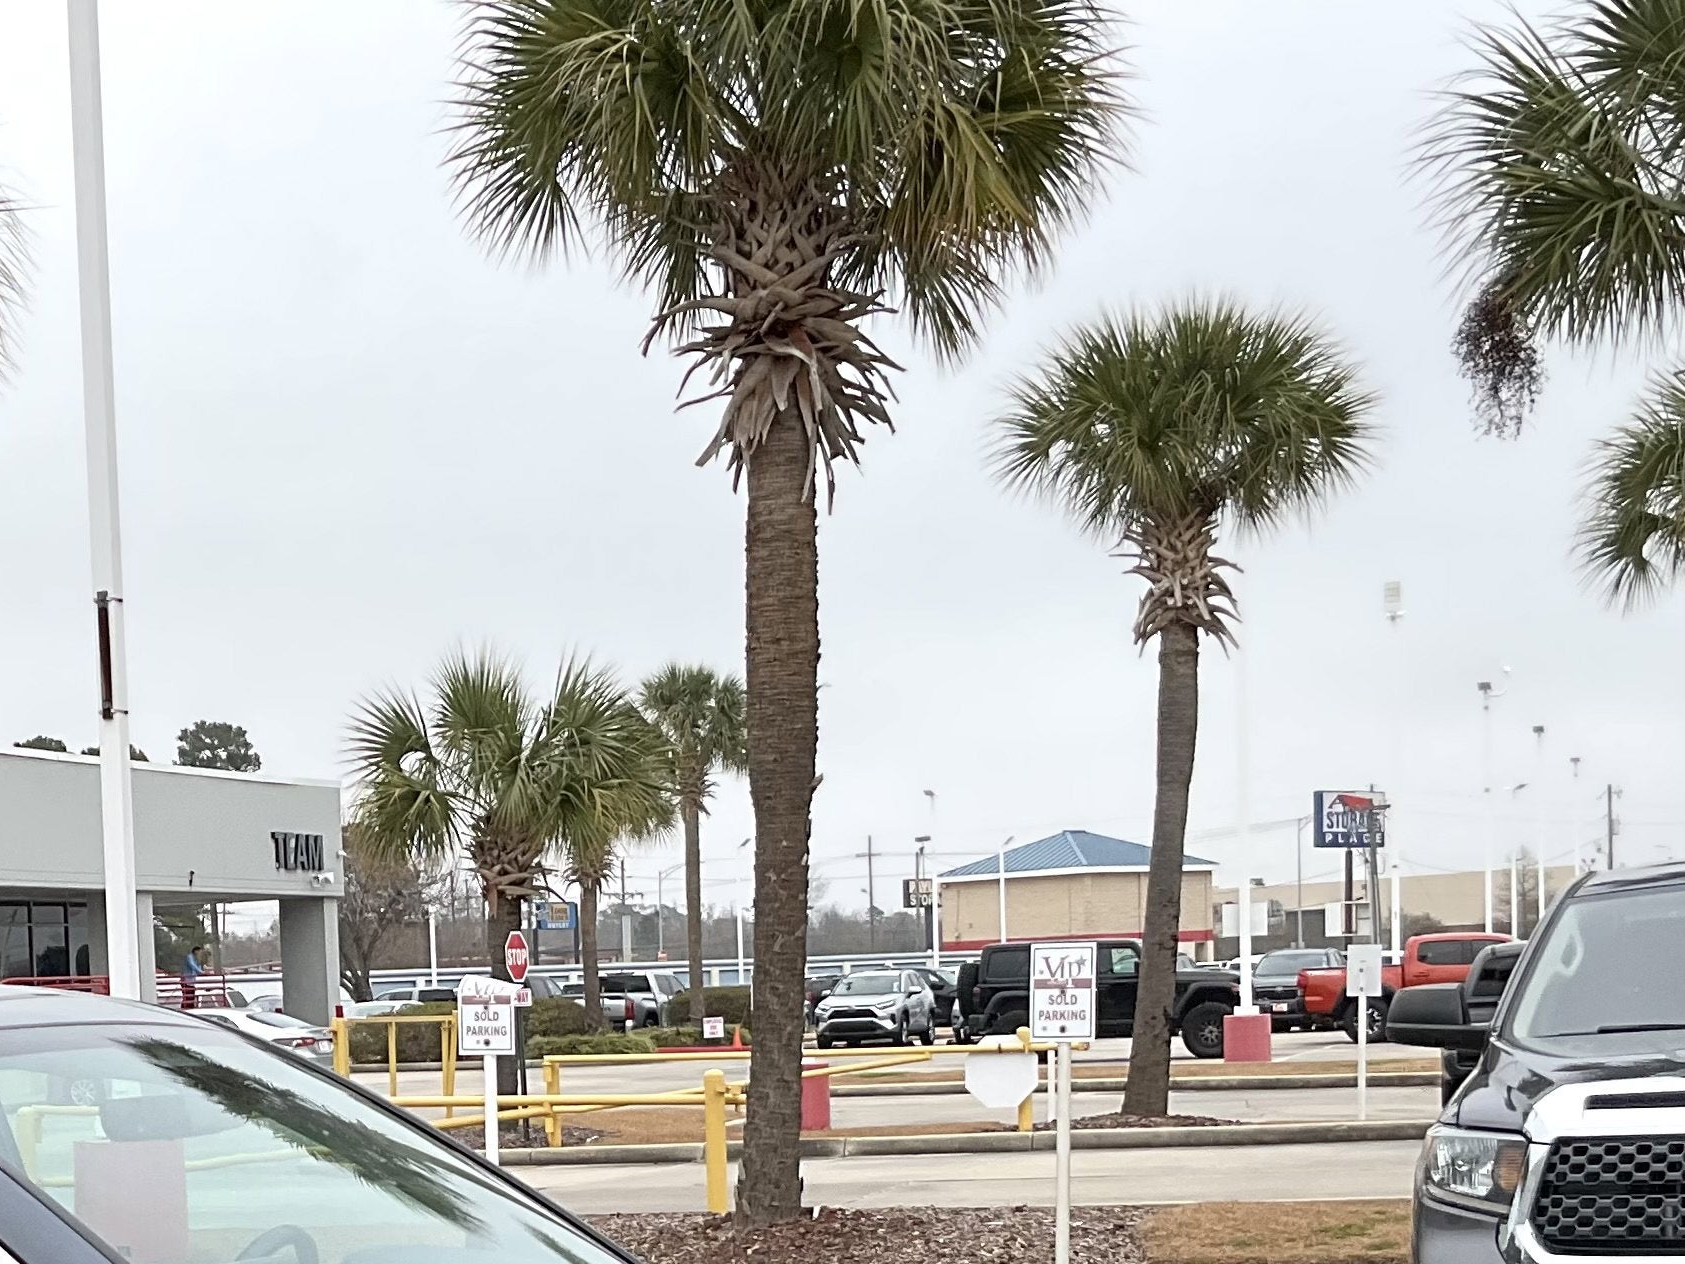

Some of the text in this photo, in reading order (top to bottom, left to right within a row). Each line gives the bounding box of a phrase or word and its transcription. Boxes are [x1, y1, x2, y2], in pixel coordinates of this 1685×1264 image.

[271, 832, 324, 871] TEAM
[507, 948, 528, 966] STOP
[1049, 995, 1078, 1005] SOLD
[474, 1011, 499, 1021] SOLD
[1038, 1010, 1086, 1021] PARKING
[466, 1025, 507, 1036] PARKING
